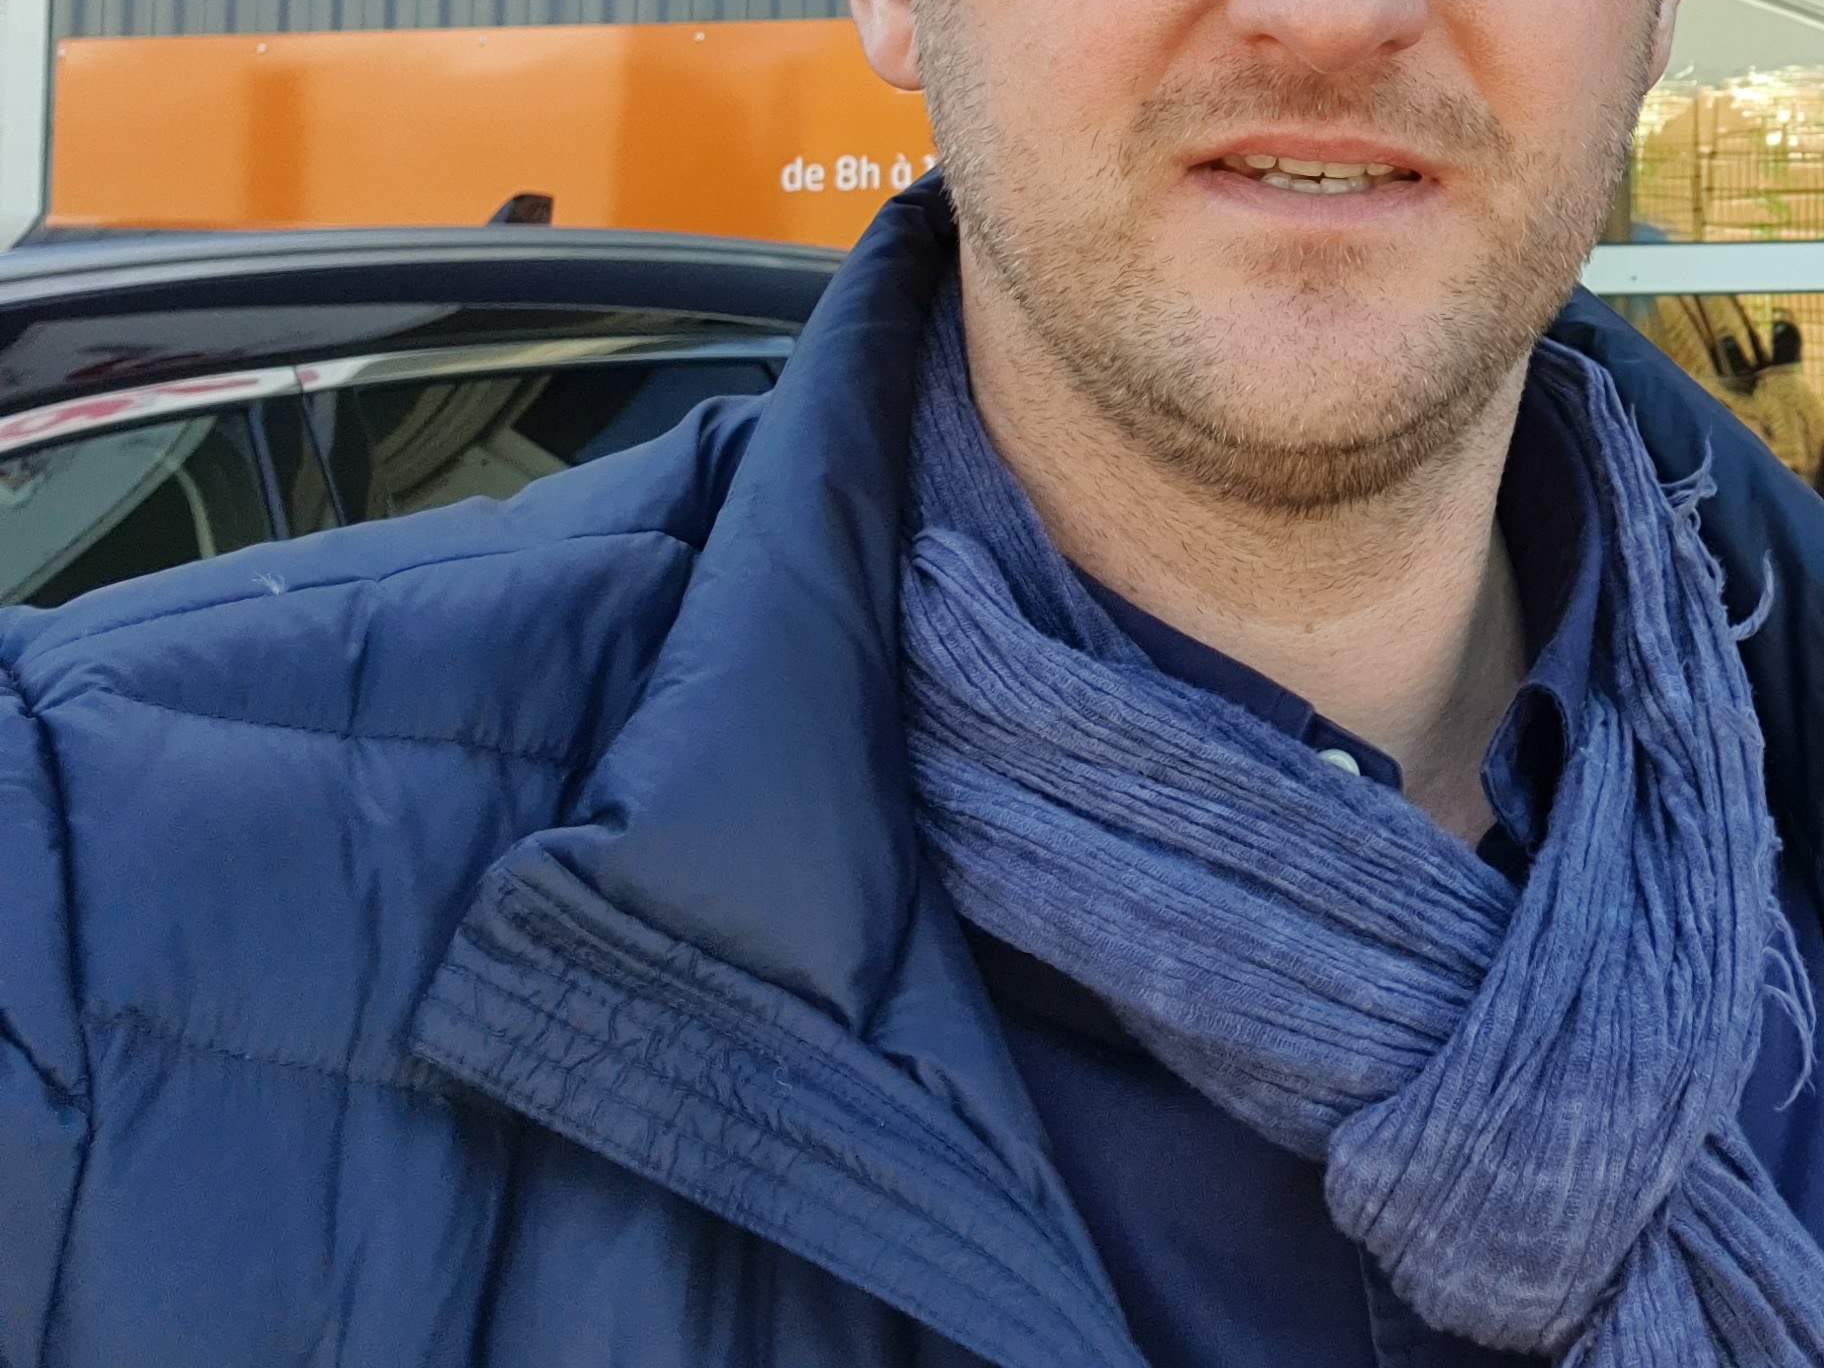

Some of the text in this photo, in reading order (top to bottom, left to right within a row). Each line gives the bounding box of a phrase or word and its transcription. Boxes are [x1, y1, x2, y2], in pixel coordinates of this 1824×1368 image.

[781, 156, 825, 192] de
[835, 155, 881, 191] 8h
[890, 152, 913, 190] à
